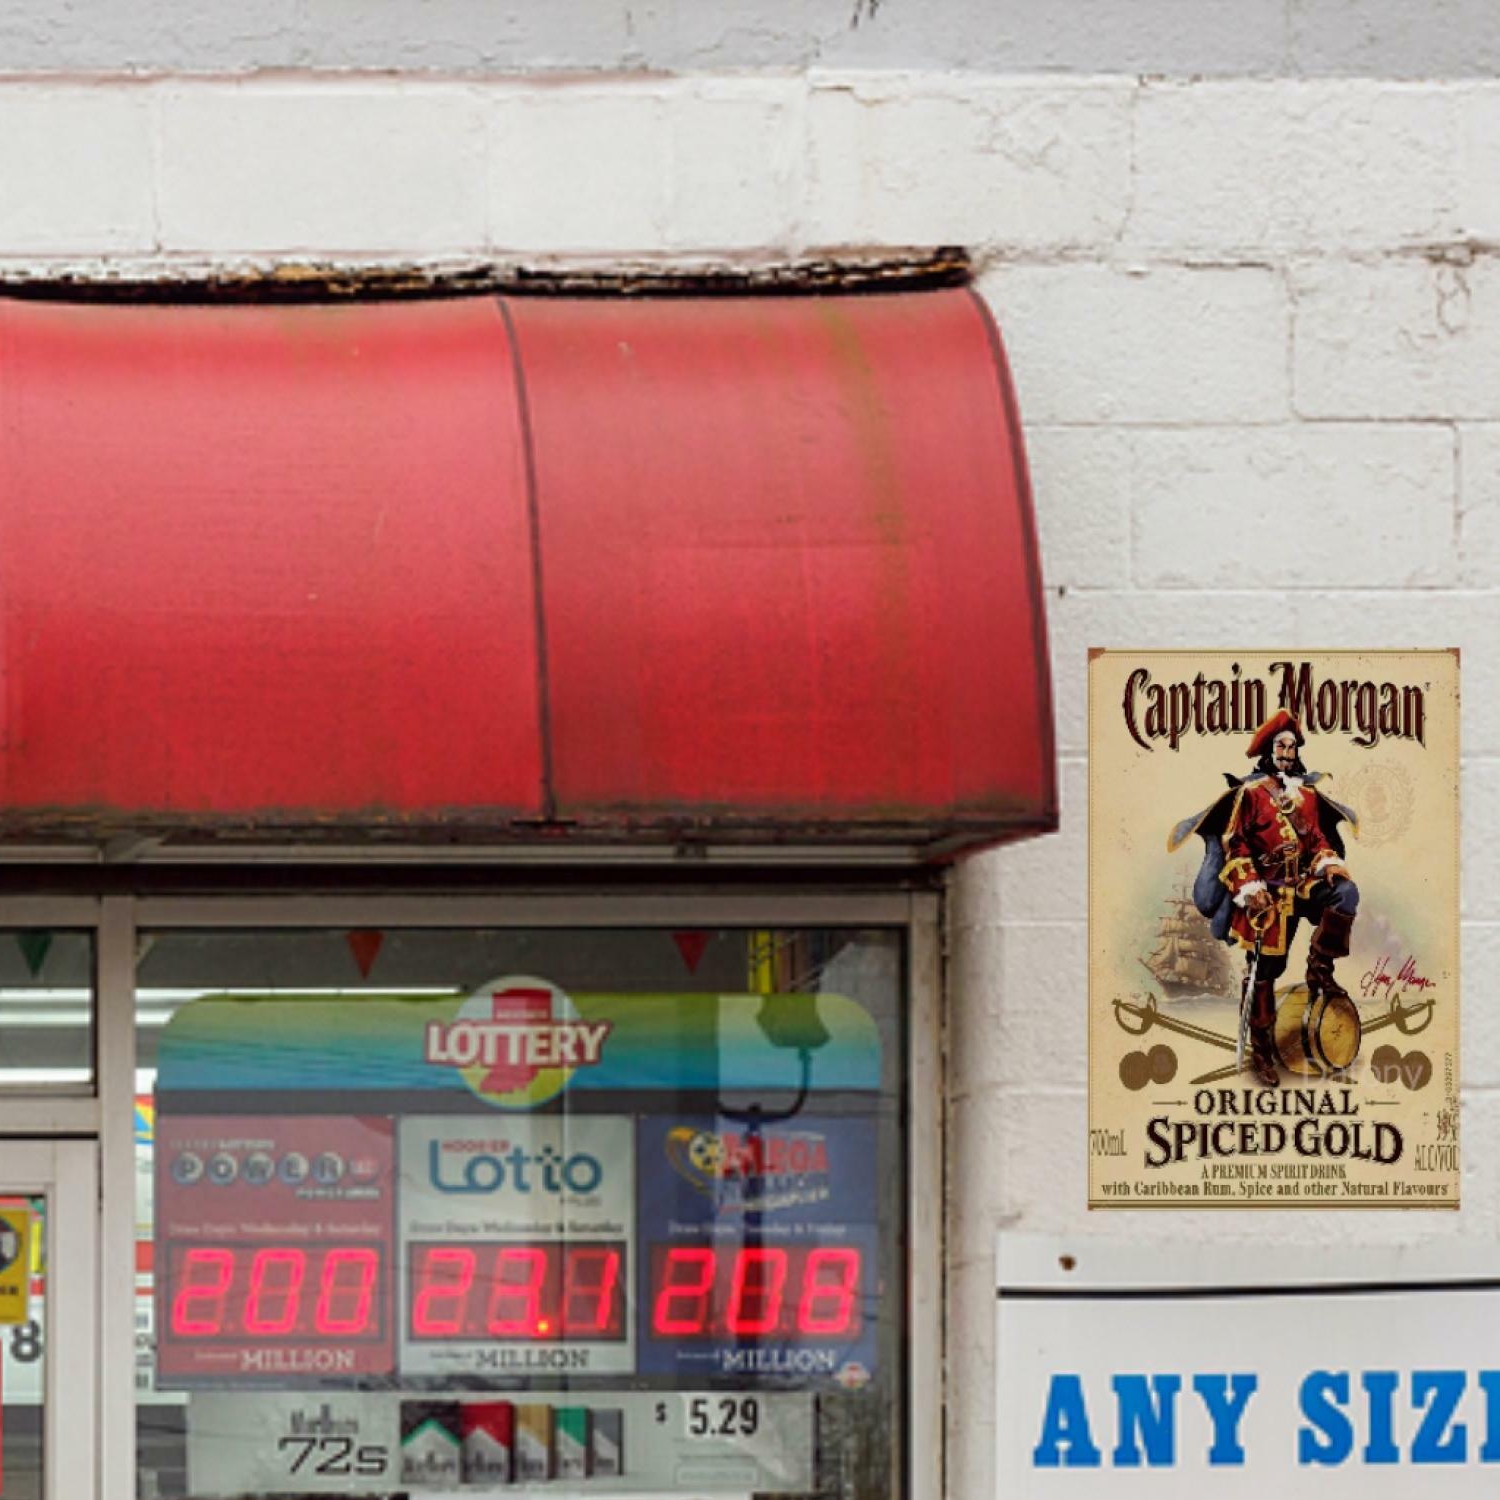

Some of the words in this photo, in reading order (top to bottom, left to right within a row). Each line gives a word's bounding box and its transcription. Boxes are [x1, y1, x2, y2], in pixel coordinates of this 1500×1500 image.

[1121, 663, 1267, 752] Captain
[1269, 660, 1427, 749] Morgan
[428, 1024, 608, 1066] LOTTERY
[1193, 1088, 1359, 1116] ORIGINAL
[1144, 1115, 1288, 1168] SPICED
[1293, 1117, 1404, 1165] GOLD
[428, 1138, 603, 1196] Lotto
[1212, 1164, 1268, 1180] PREMIUM
[1270, 1164, 1309, 1180] SPIRIT
[1311, 1164, 1347, 1180] DRINK
[1102, 1181, 1131, 1197] with
[1134, 1181, 1200, 1197] Caribbean
[1238, 1181, 1273, 1199] Spice
[1276, 1181, 1300, 1197] and
[1303, 1181, 1338, 1197] other
[1341, 1181, 1390, 1197] Natural
[1392, 1181, 1449, 1197] Flavours
[171, 1247, 380, 1336] 200
[412, 1247, 620, 1336] 23.1
[652, 1247, 862, 1336] 208
[241, 1349, 356, 1370] MILLION
[475, 1349, 591, 1369] MILLION
[721, 1349, 836, 1372] MILLION
[688, 1399, 760, 1436] 5.29
[1033, 1373, 1258, 1467] ANY
[277, 1436, 389, 1475] 72s
